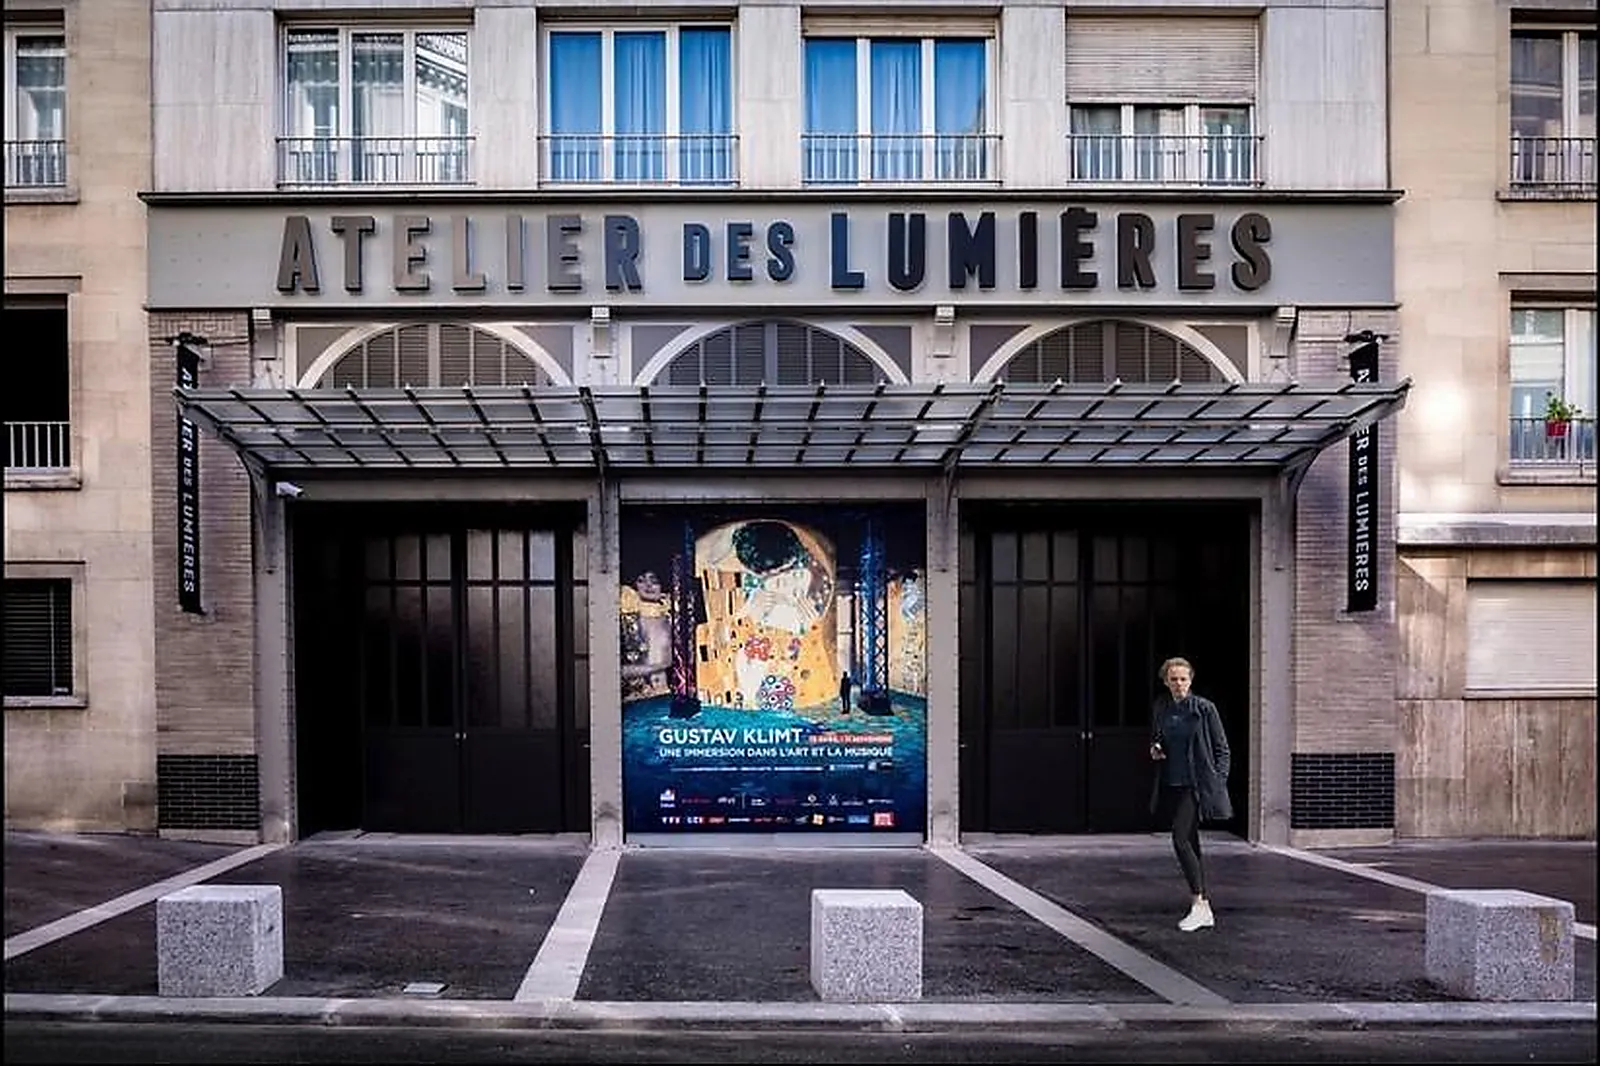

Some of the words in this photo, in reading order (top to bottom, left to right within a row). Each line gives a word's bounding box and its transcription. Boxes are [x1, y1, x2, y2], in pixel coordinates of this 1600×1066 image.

[276, 213, 645, 294] ATELIER
[682, 221, 796, 283] DES
[182, 366, 193, 452] ATIER
[183, 456, 193, 487] DES
[1357, 455, 1368, 486] DES
[659, 728, 738, 745] GUSTAV
[743, 728, 803, 744] KLIMT
[660, 747, 681, 758] UNE
[683, 747, 745, 758] IMMERSION
[747, 747, 778, 758] DANS
[780, 747, 809, 758] L'ART
[811, 747, 824, 757] ET
[827, 747, 842, 757] LA
[844, 746, 893, 758] MUSIQUE
